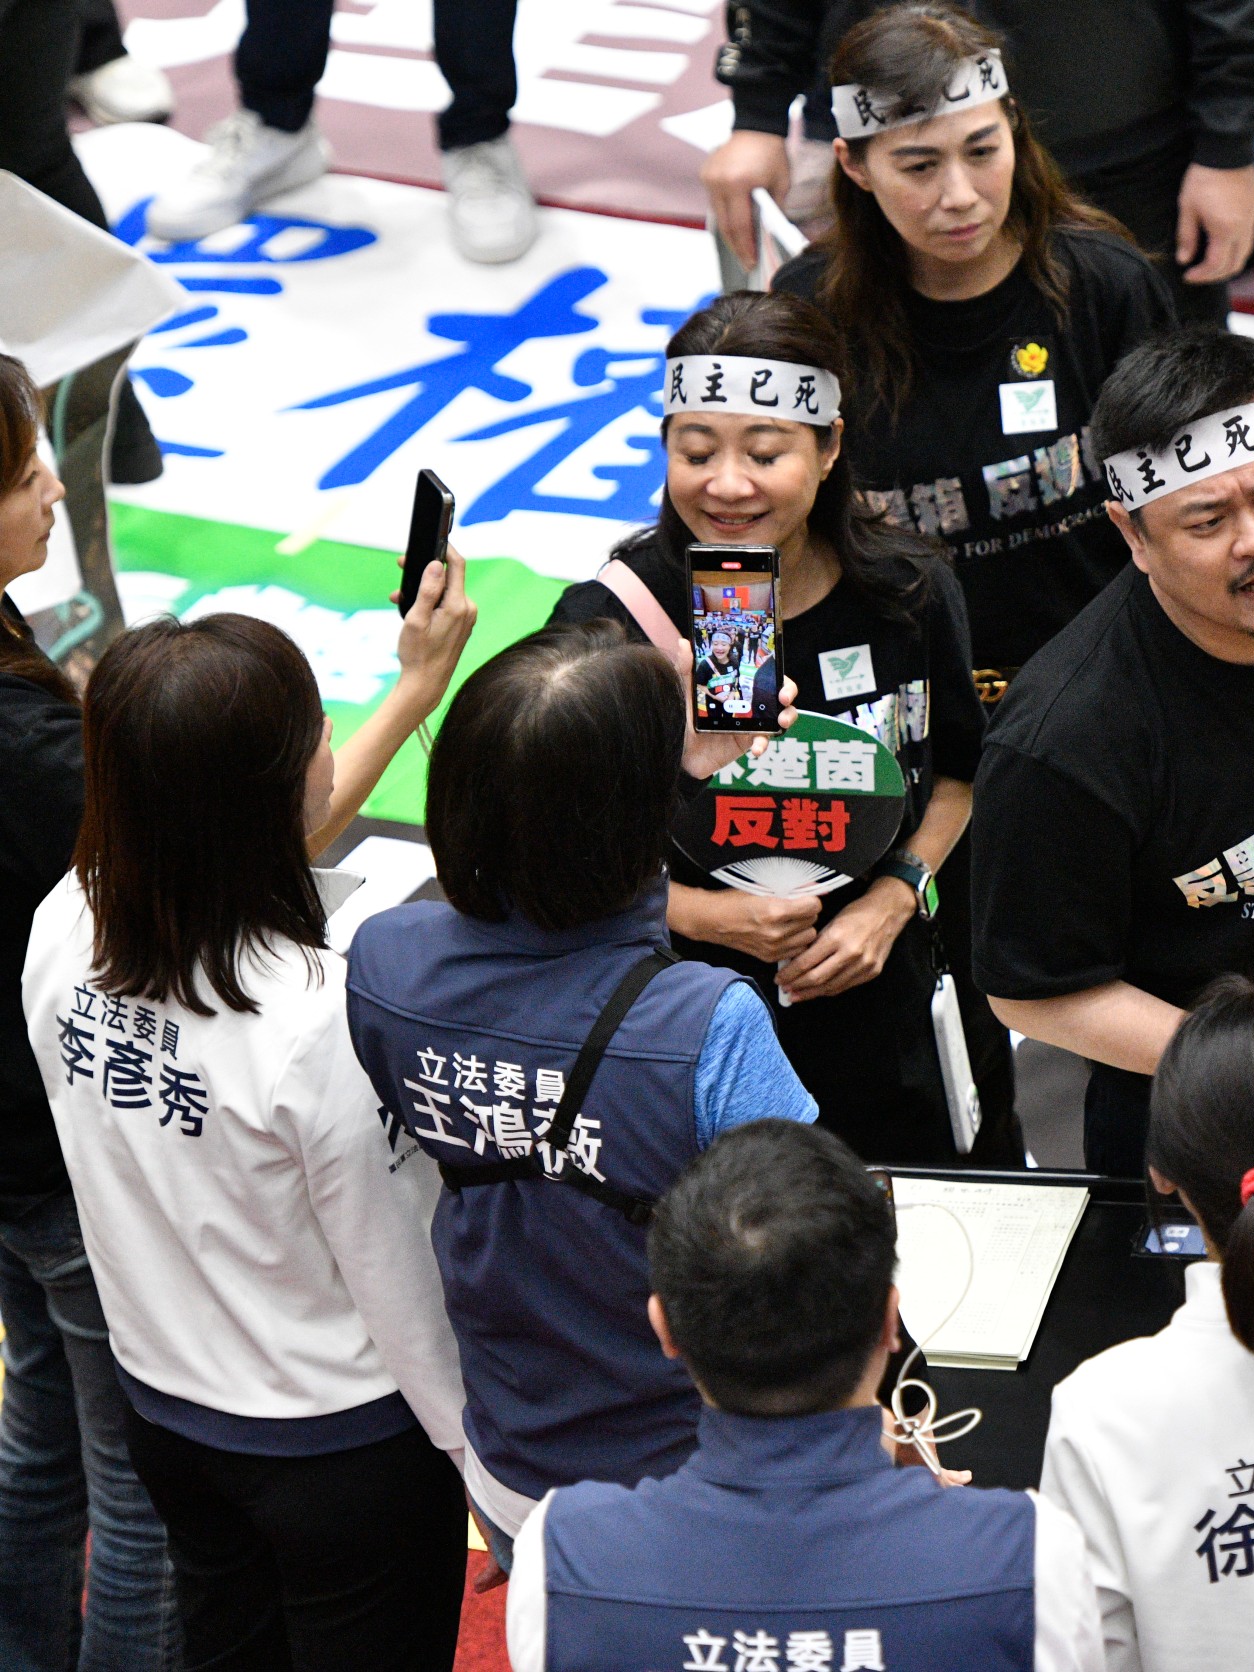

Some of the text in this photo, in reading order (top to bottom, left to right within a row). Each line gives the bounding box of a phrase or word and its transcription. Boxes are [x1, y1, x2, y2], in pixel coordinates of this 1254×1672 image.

[853, 57, 998, 127] 民死
[669, 362, 819, 415] 民主已死
[710, 795, 851, 853] 反對
[71, 983, 180, 1061] 立法委員
[56, 1013, 209, 1138] 李彥秀
[416, 1046, 566, 1104] 立法委員
[682, 1627, 886, 1672] 立法委員
